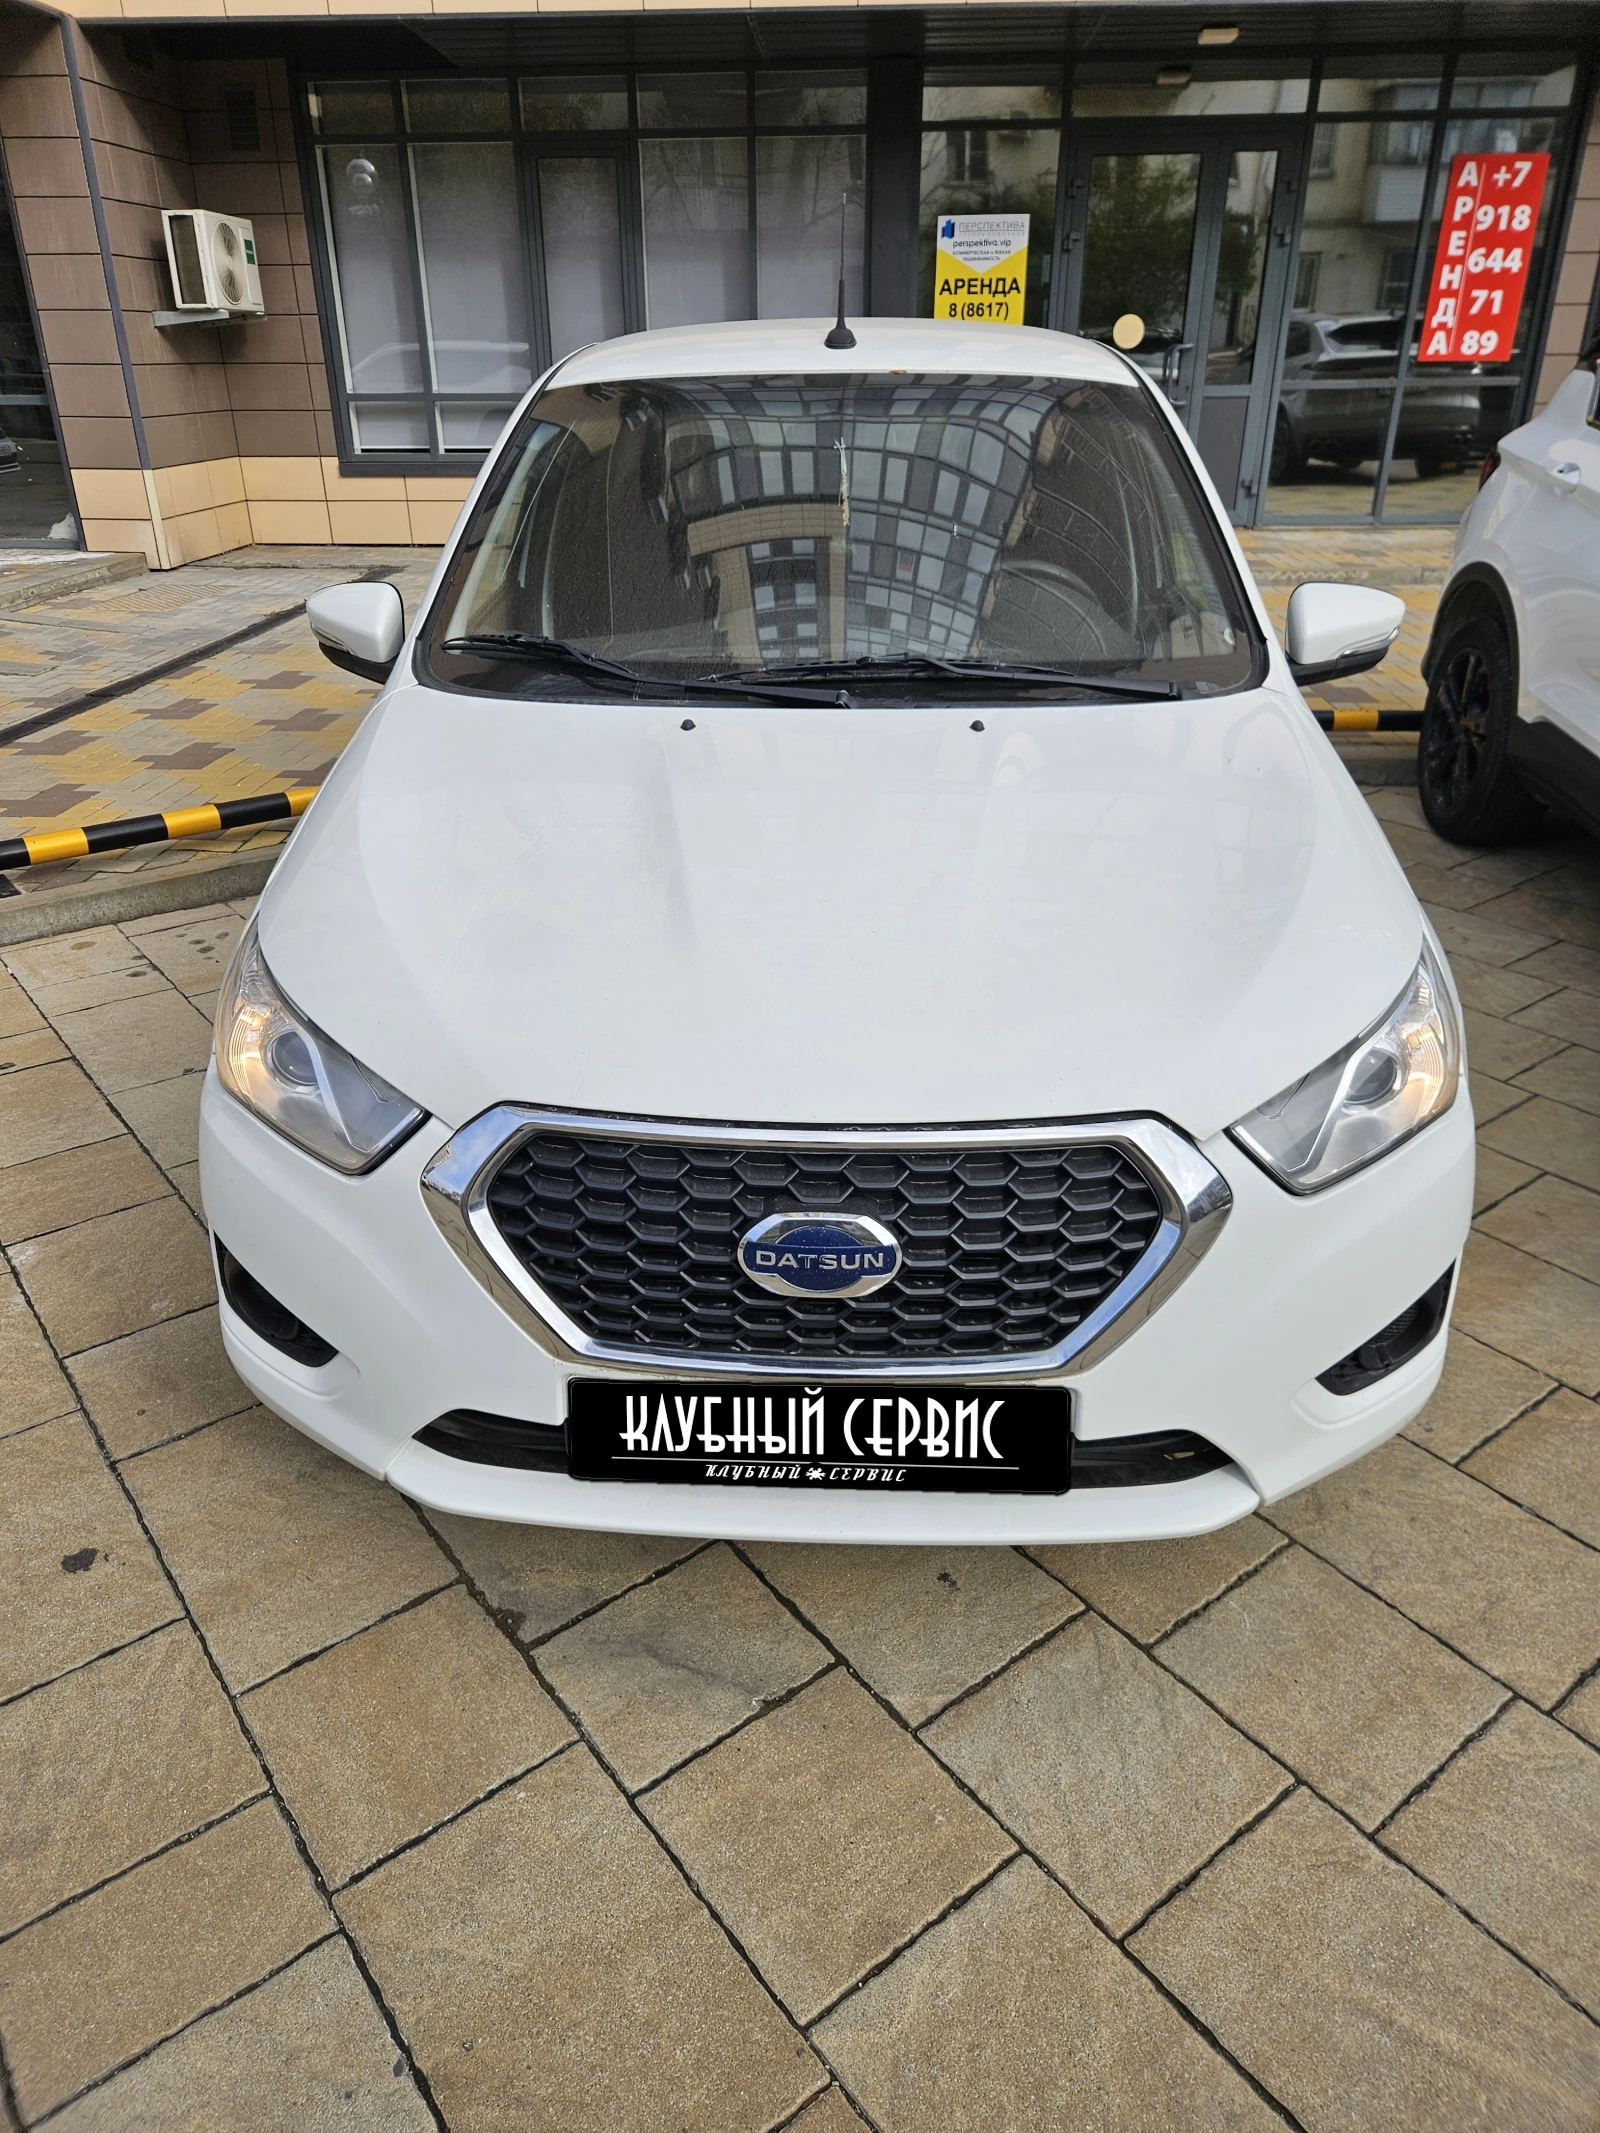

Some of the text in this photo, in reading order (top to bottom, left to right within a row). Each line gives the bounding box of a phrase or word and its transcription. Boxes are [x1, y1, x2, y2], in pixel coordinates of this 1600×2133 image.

[1492, 161, 1533, 188] +7
[959, 221, 1025, 231] ПЕРСПЕКТИВА
[1475, 204, 1532, 231] 918
[953, 239, 1011, 248] perspektiva.vip
[1467, 247, 1524, 274] 644
[939, 277, 1021, 298] АРЕНДА
[949, 302, 1009, 321] 8 (8617)
[1468, 289, 1504, 315] 71
[1460, 330, 1499, 356] 89
[755, 1250, 884, 1270] DATSUN
